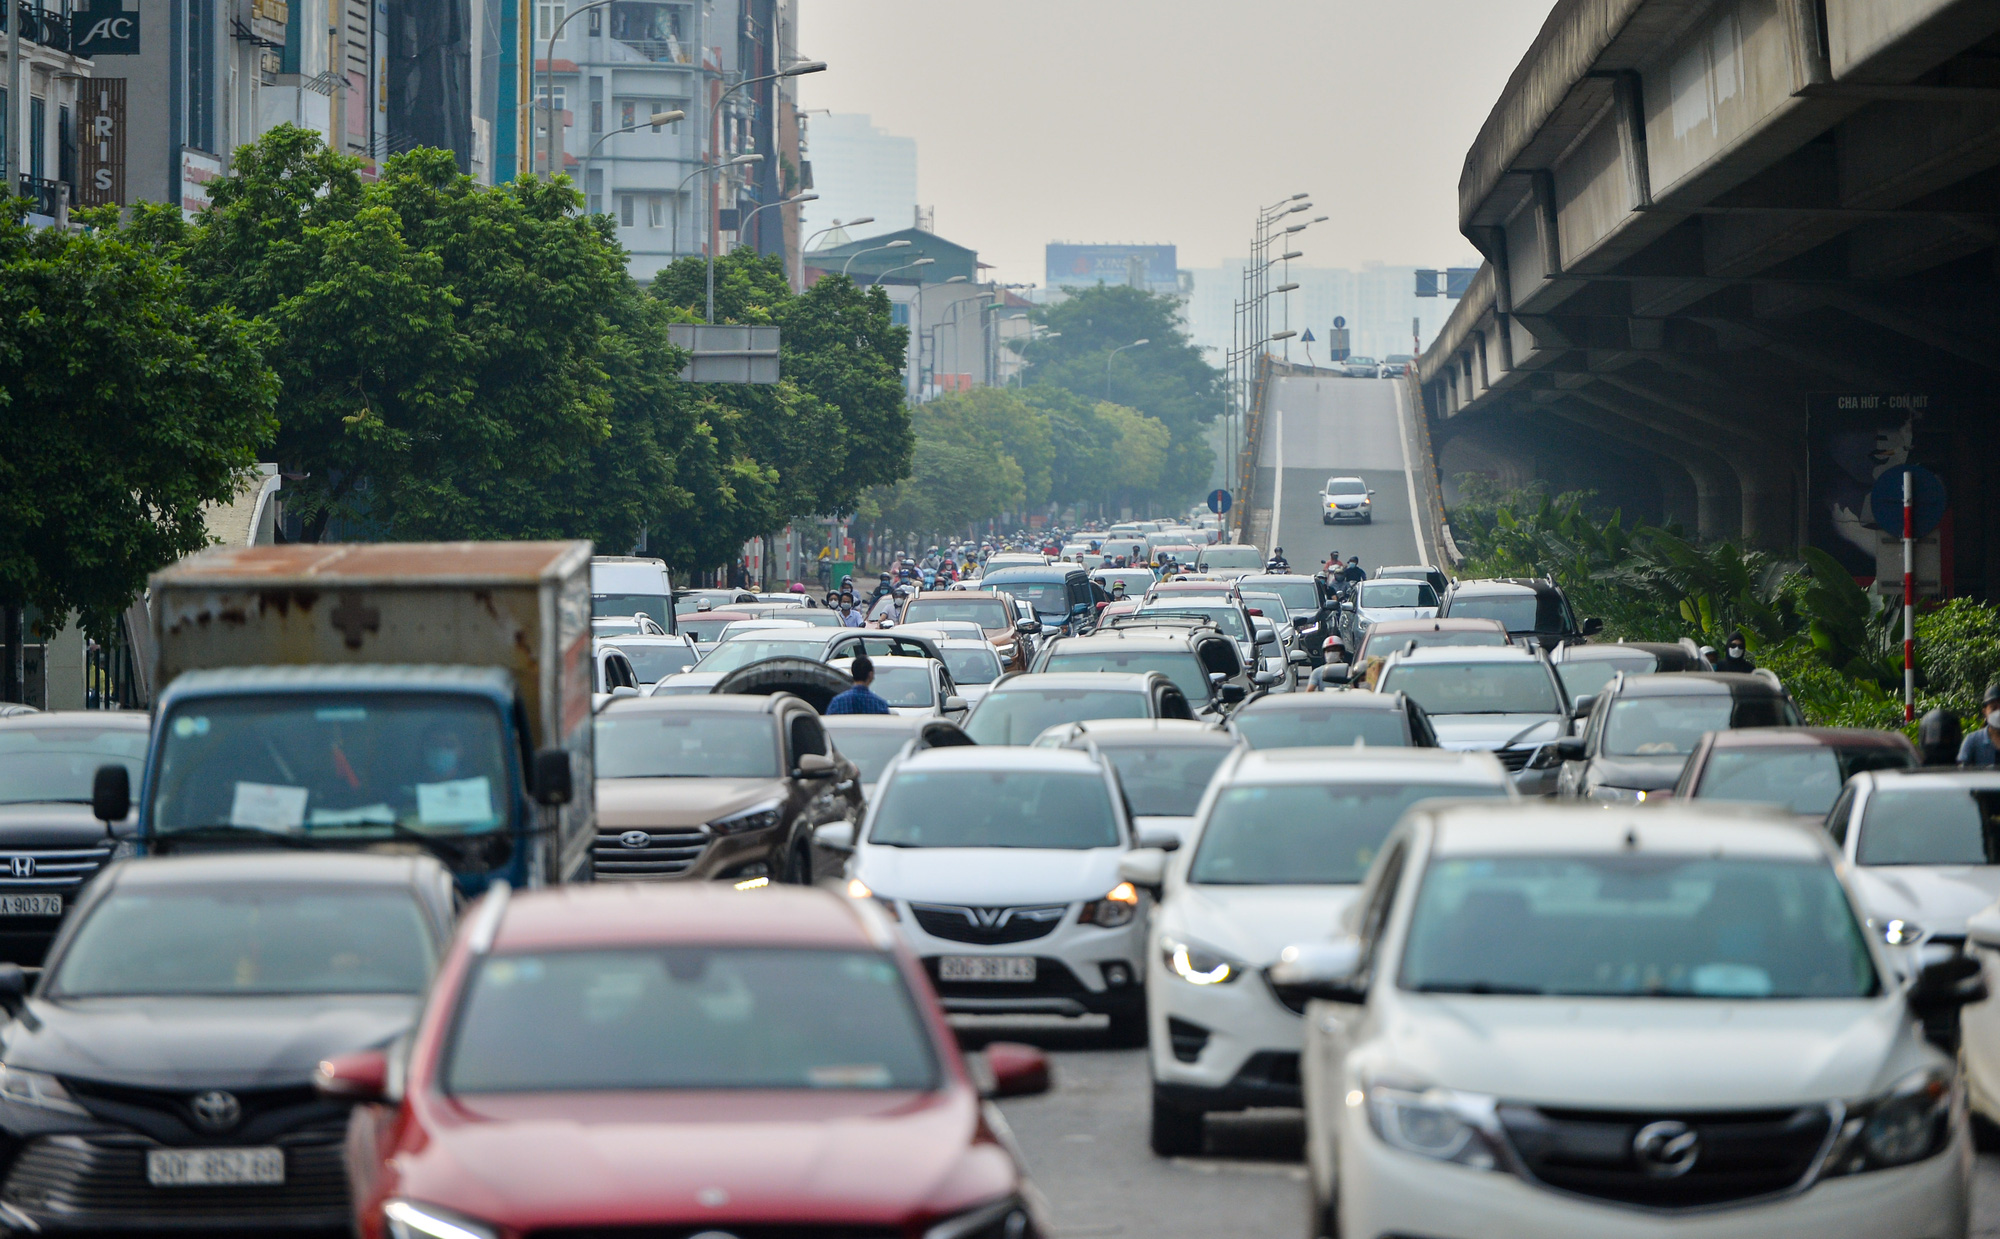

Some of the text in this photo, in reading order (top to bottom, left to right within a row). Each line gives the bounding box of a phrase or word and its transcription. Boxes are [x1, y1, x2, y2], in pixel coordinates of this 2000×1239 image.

[78, 17, 133, 46] AC
[95, 90, 113, 190] IRIS
[1838, 396, 1858, 409] CHA
[1889, 396, 1910, 409] CON
